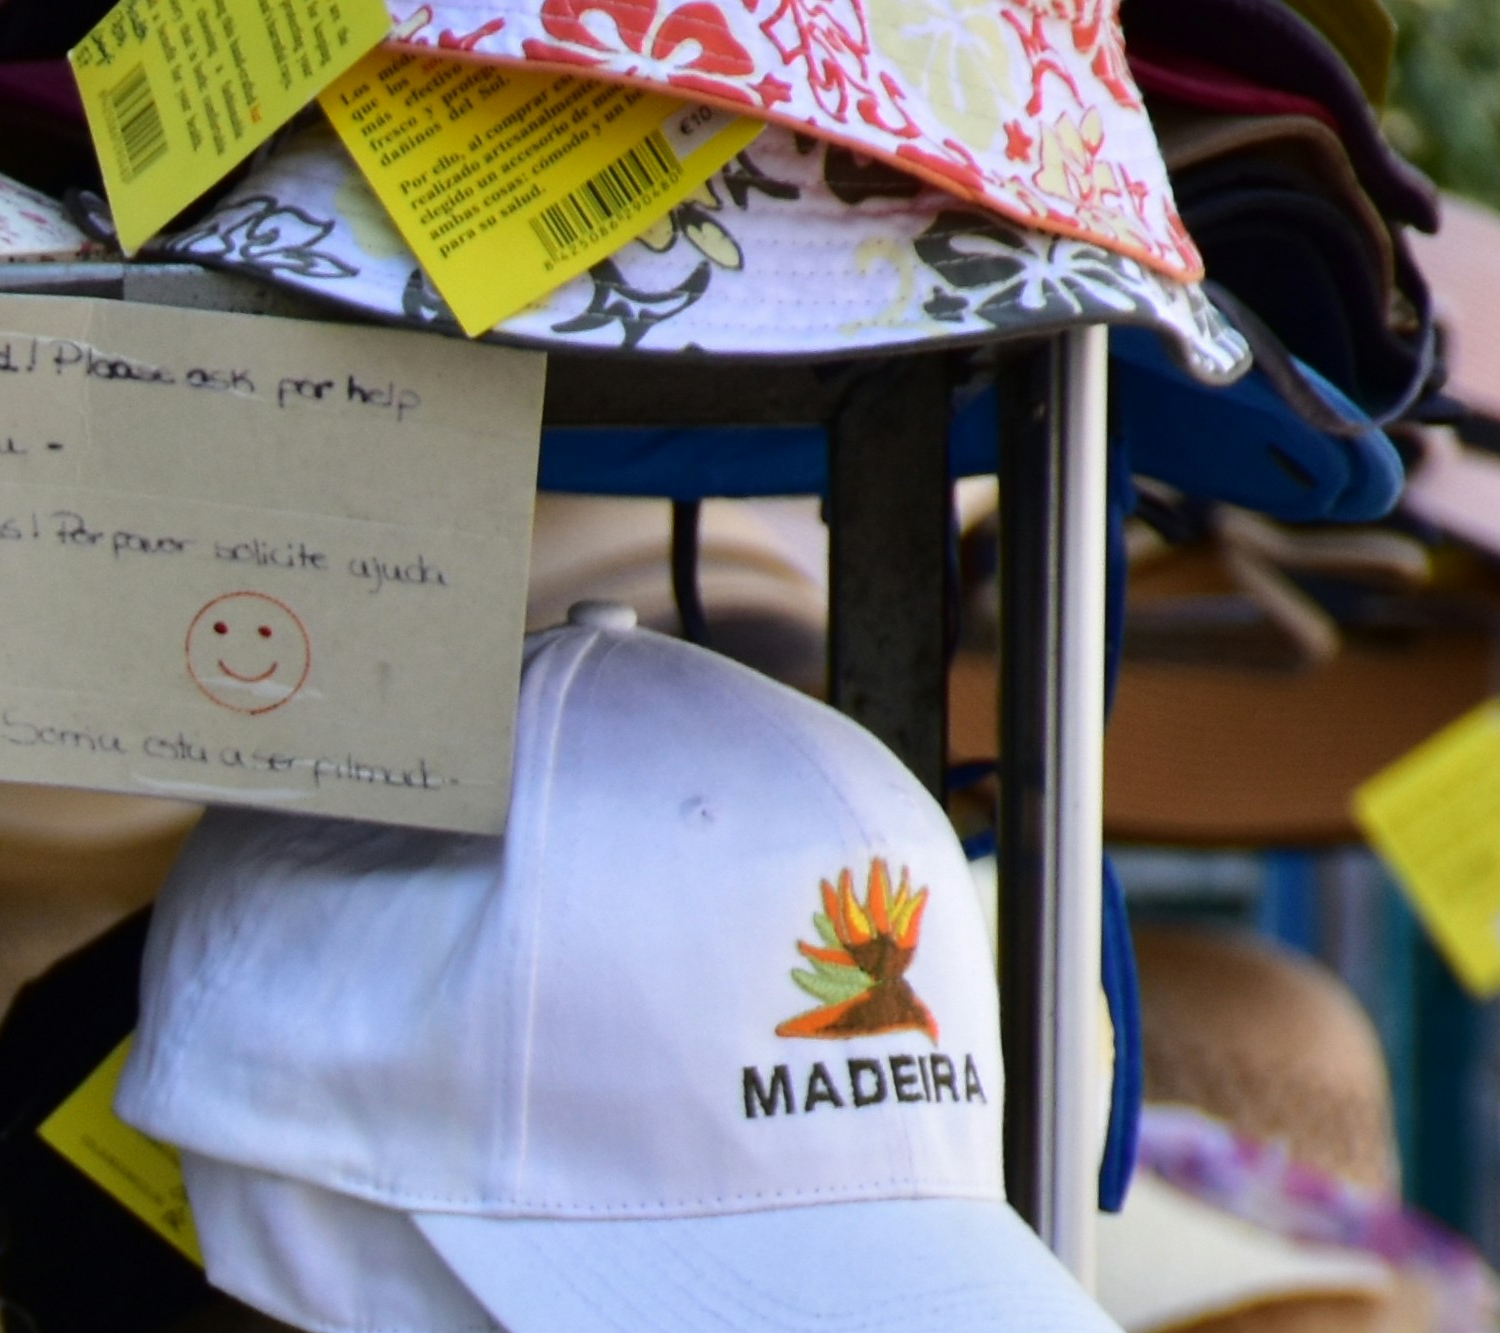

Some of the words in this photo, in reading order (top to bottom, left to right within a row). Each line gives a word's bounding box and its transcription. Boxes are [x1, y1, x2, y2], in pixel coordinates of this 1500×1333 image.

[53, 340, 176, 385] Please
[347, 374, 421, 422] help
[51, 509, 105, 546] Por
[214, 537, 330, 572] solicite
[742, 1053, 988, 1119] MADEIRA
